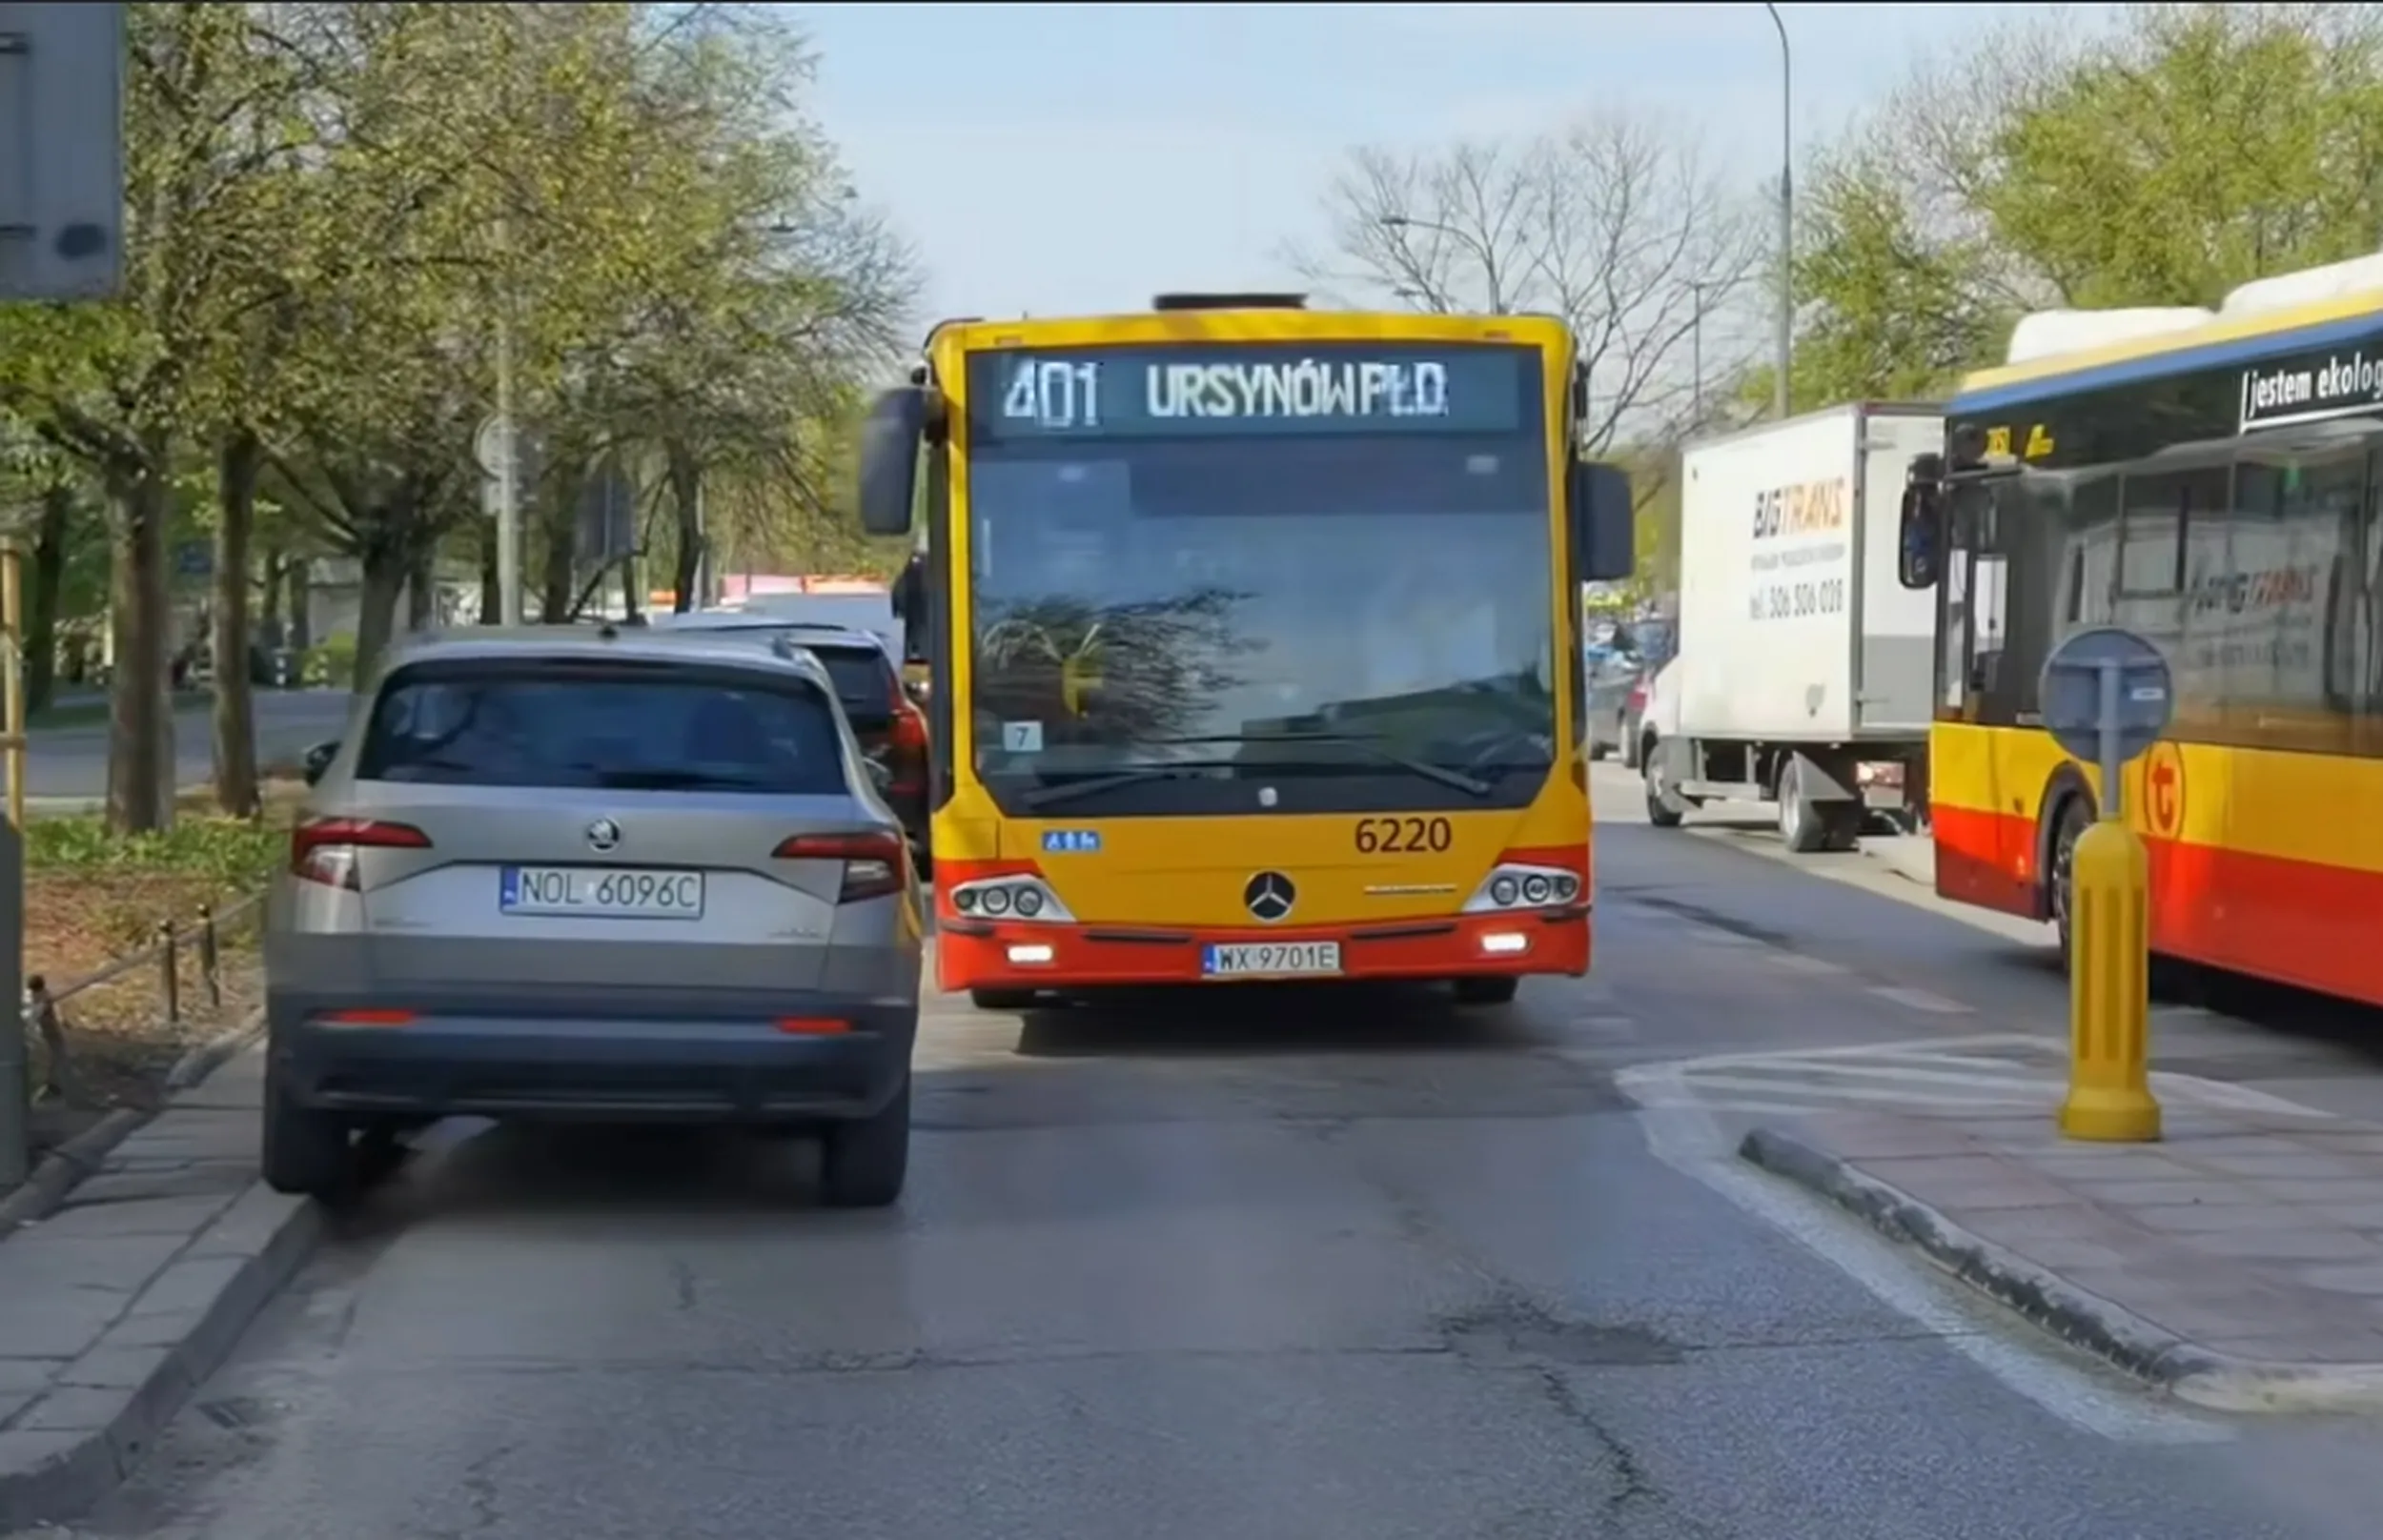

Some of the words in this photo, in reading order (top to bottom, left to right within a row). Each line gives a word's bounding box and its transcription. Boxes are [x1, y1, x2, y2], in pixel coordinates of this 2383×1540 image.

[1004, 359, 1098, 427] 401
[1147, 357, 1354, 417] URSYNÓW
[2248, 368, 2312, 419] jestem
[1015, 725, 1030, 748] 7
[1354, 816, 1453, 854] 6220
[521, 870, 583, 904] NOL
[595, 873, 698, 908] 6096C
[1219, 946, 1251, 970] WX
[1258, 944, 1335, 969] 9701E
